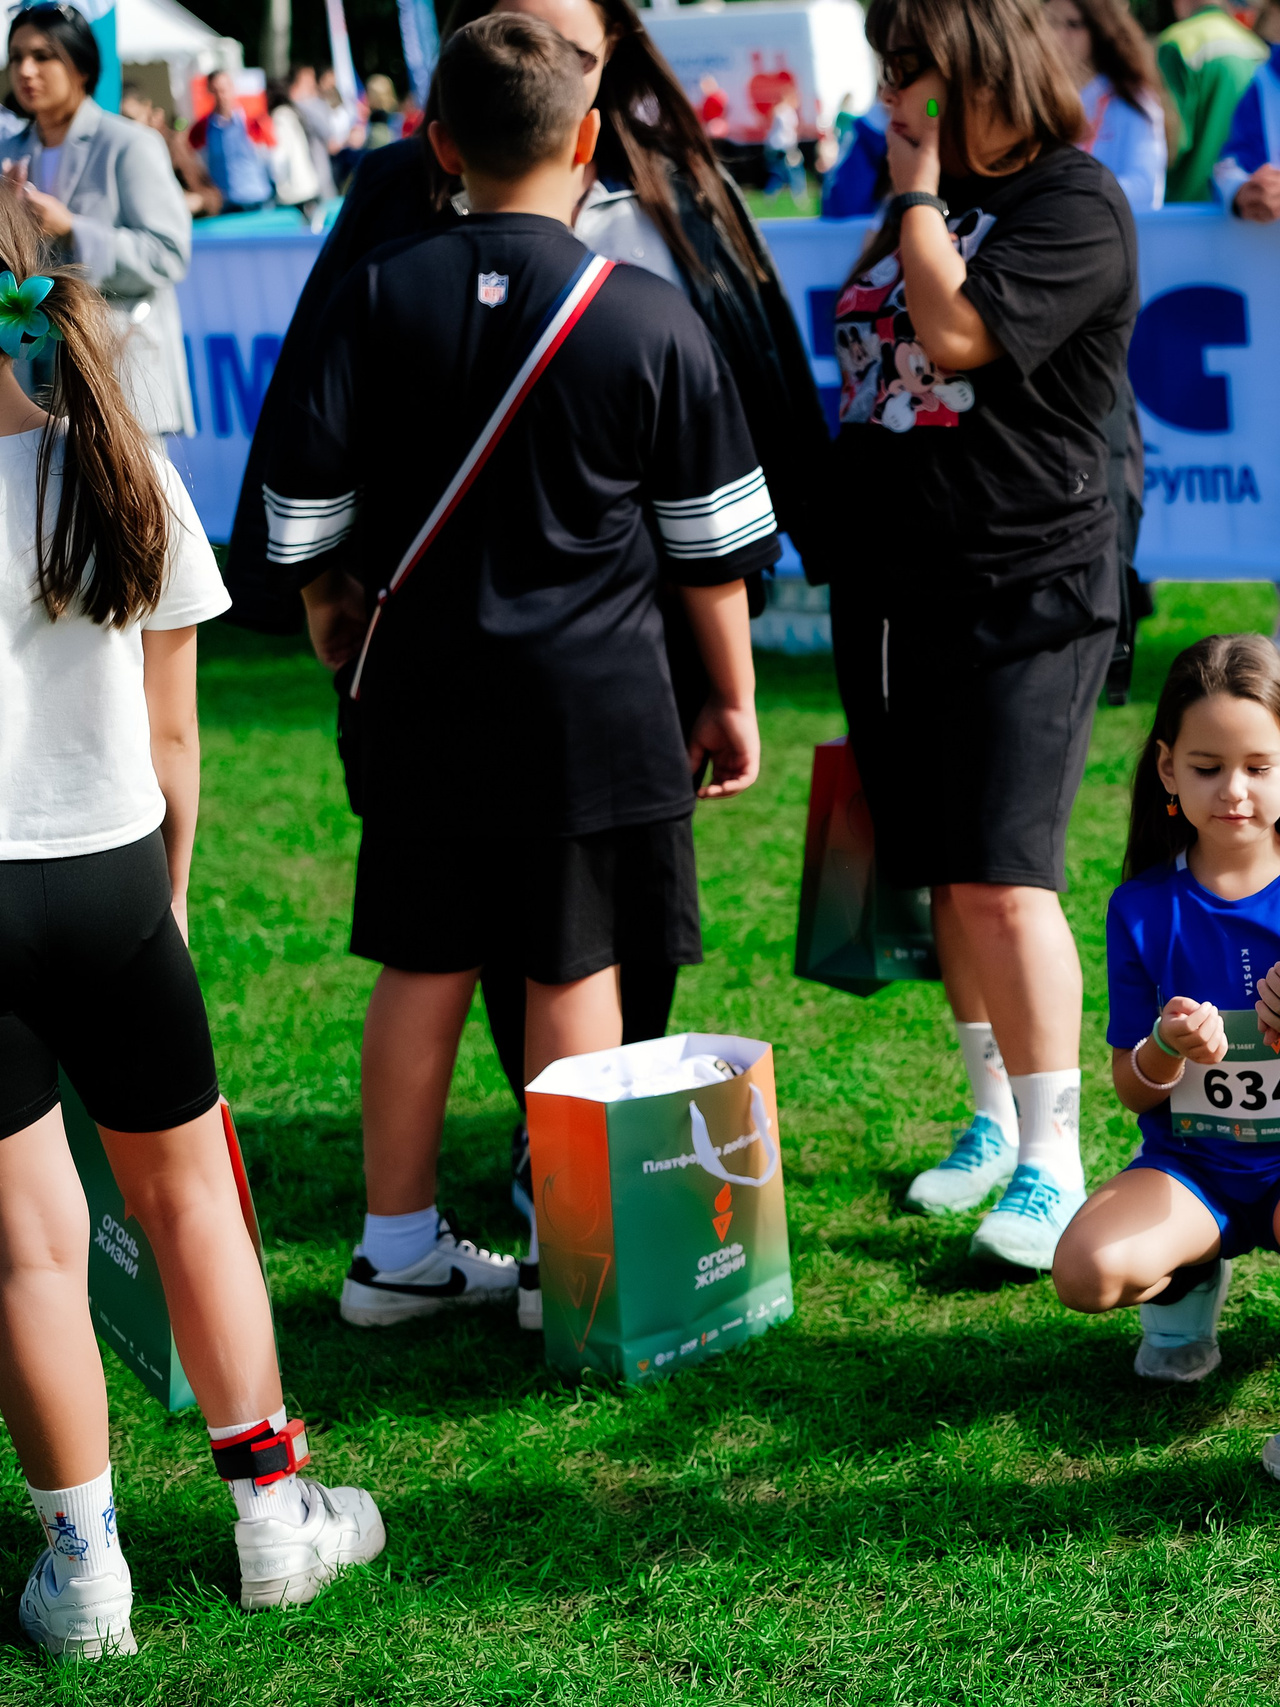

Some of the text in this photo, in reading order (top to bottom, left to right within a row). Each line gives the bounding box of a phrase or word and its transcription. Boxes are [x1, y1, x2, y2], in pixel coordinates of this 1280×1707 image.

[1144, 465, 1261, 504] РУППА
[1241, 948, 1254, 996] KIPSTA
[94, 1227, 139, 1279] ЖИЗНИ
[102, 1213, 140, 1258] ОГОНЬ
[694, 1253, 746, 1290] ЖИЗНИ
[698, 1242, 743, 1272] ОГОНЬ
[66, 1608, 124, 1634] SPORT
